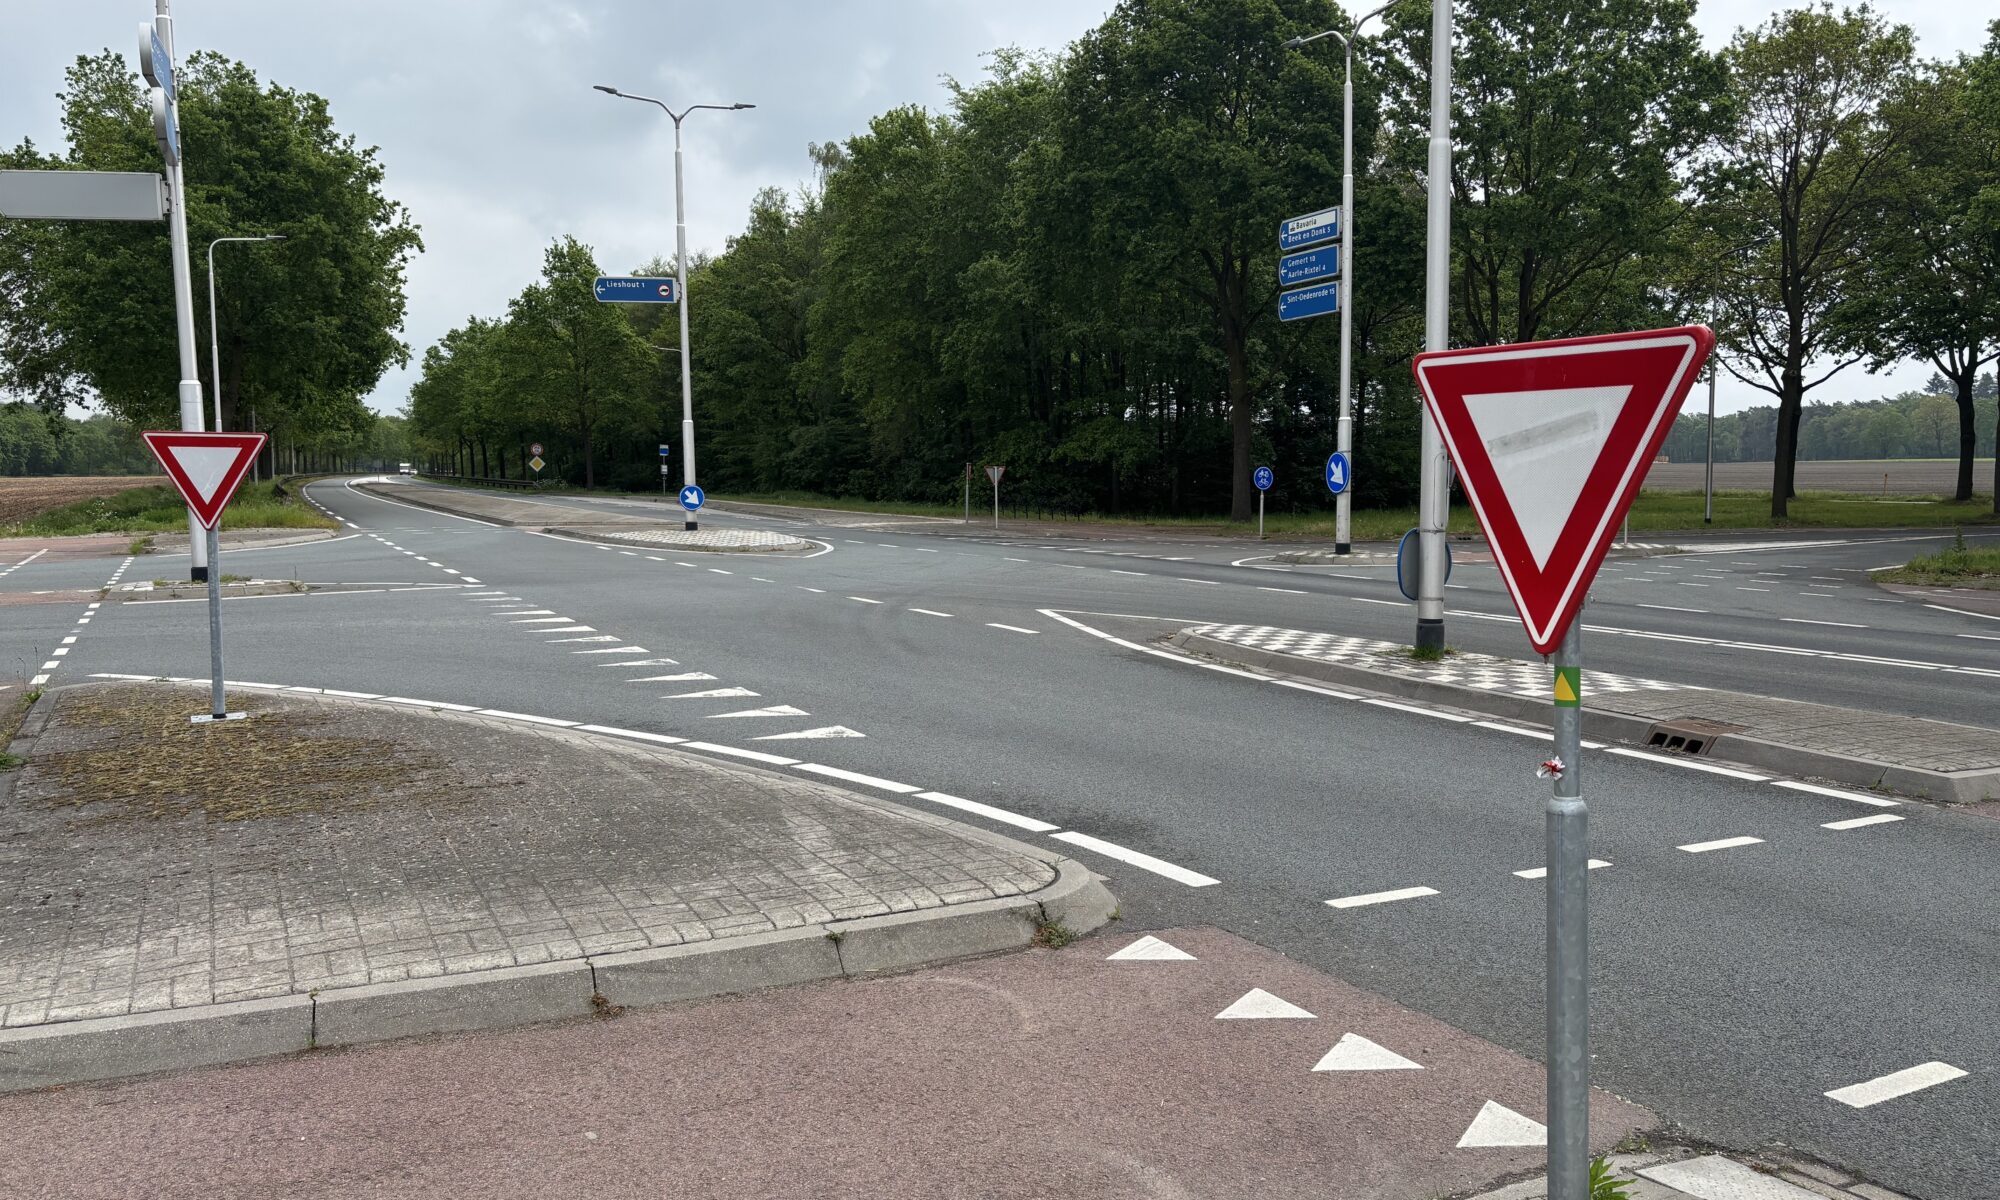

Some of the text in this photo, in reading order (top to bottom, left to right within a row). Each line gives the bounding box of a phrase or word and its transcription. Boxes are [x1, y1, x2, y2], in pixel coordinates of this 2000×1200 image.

[1296, 218, 1317, 229] Bavaria
[1288, 233, 1301, 243] Beek
[1311, 227, 1326, 237] Donk
[1287, 256, 1308, 267] Gemert
[1287, 264, 1321, 279] Aarle-Rixtel
[1287, 287, 1335, 303] Sint-Oedenrode 15
